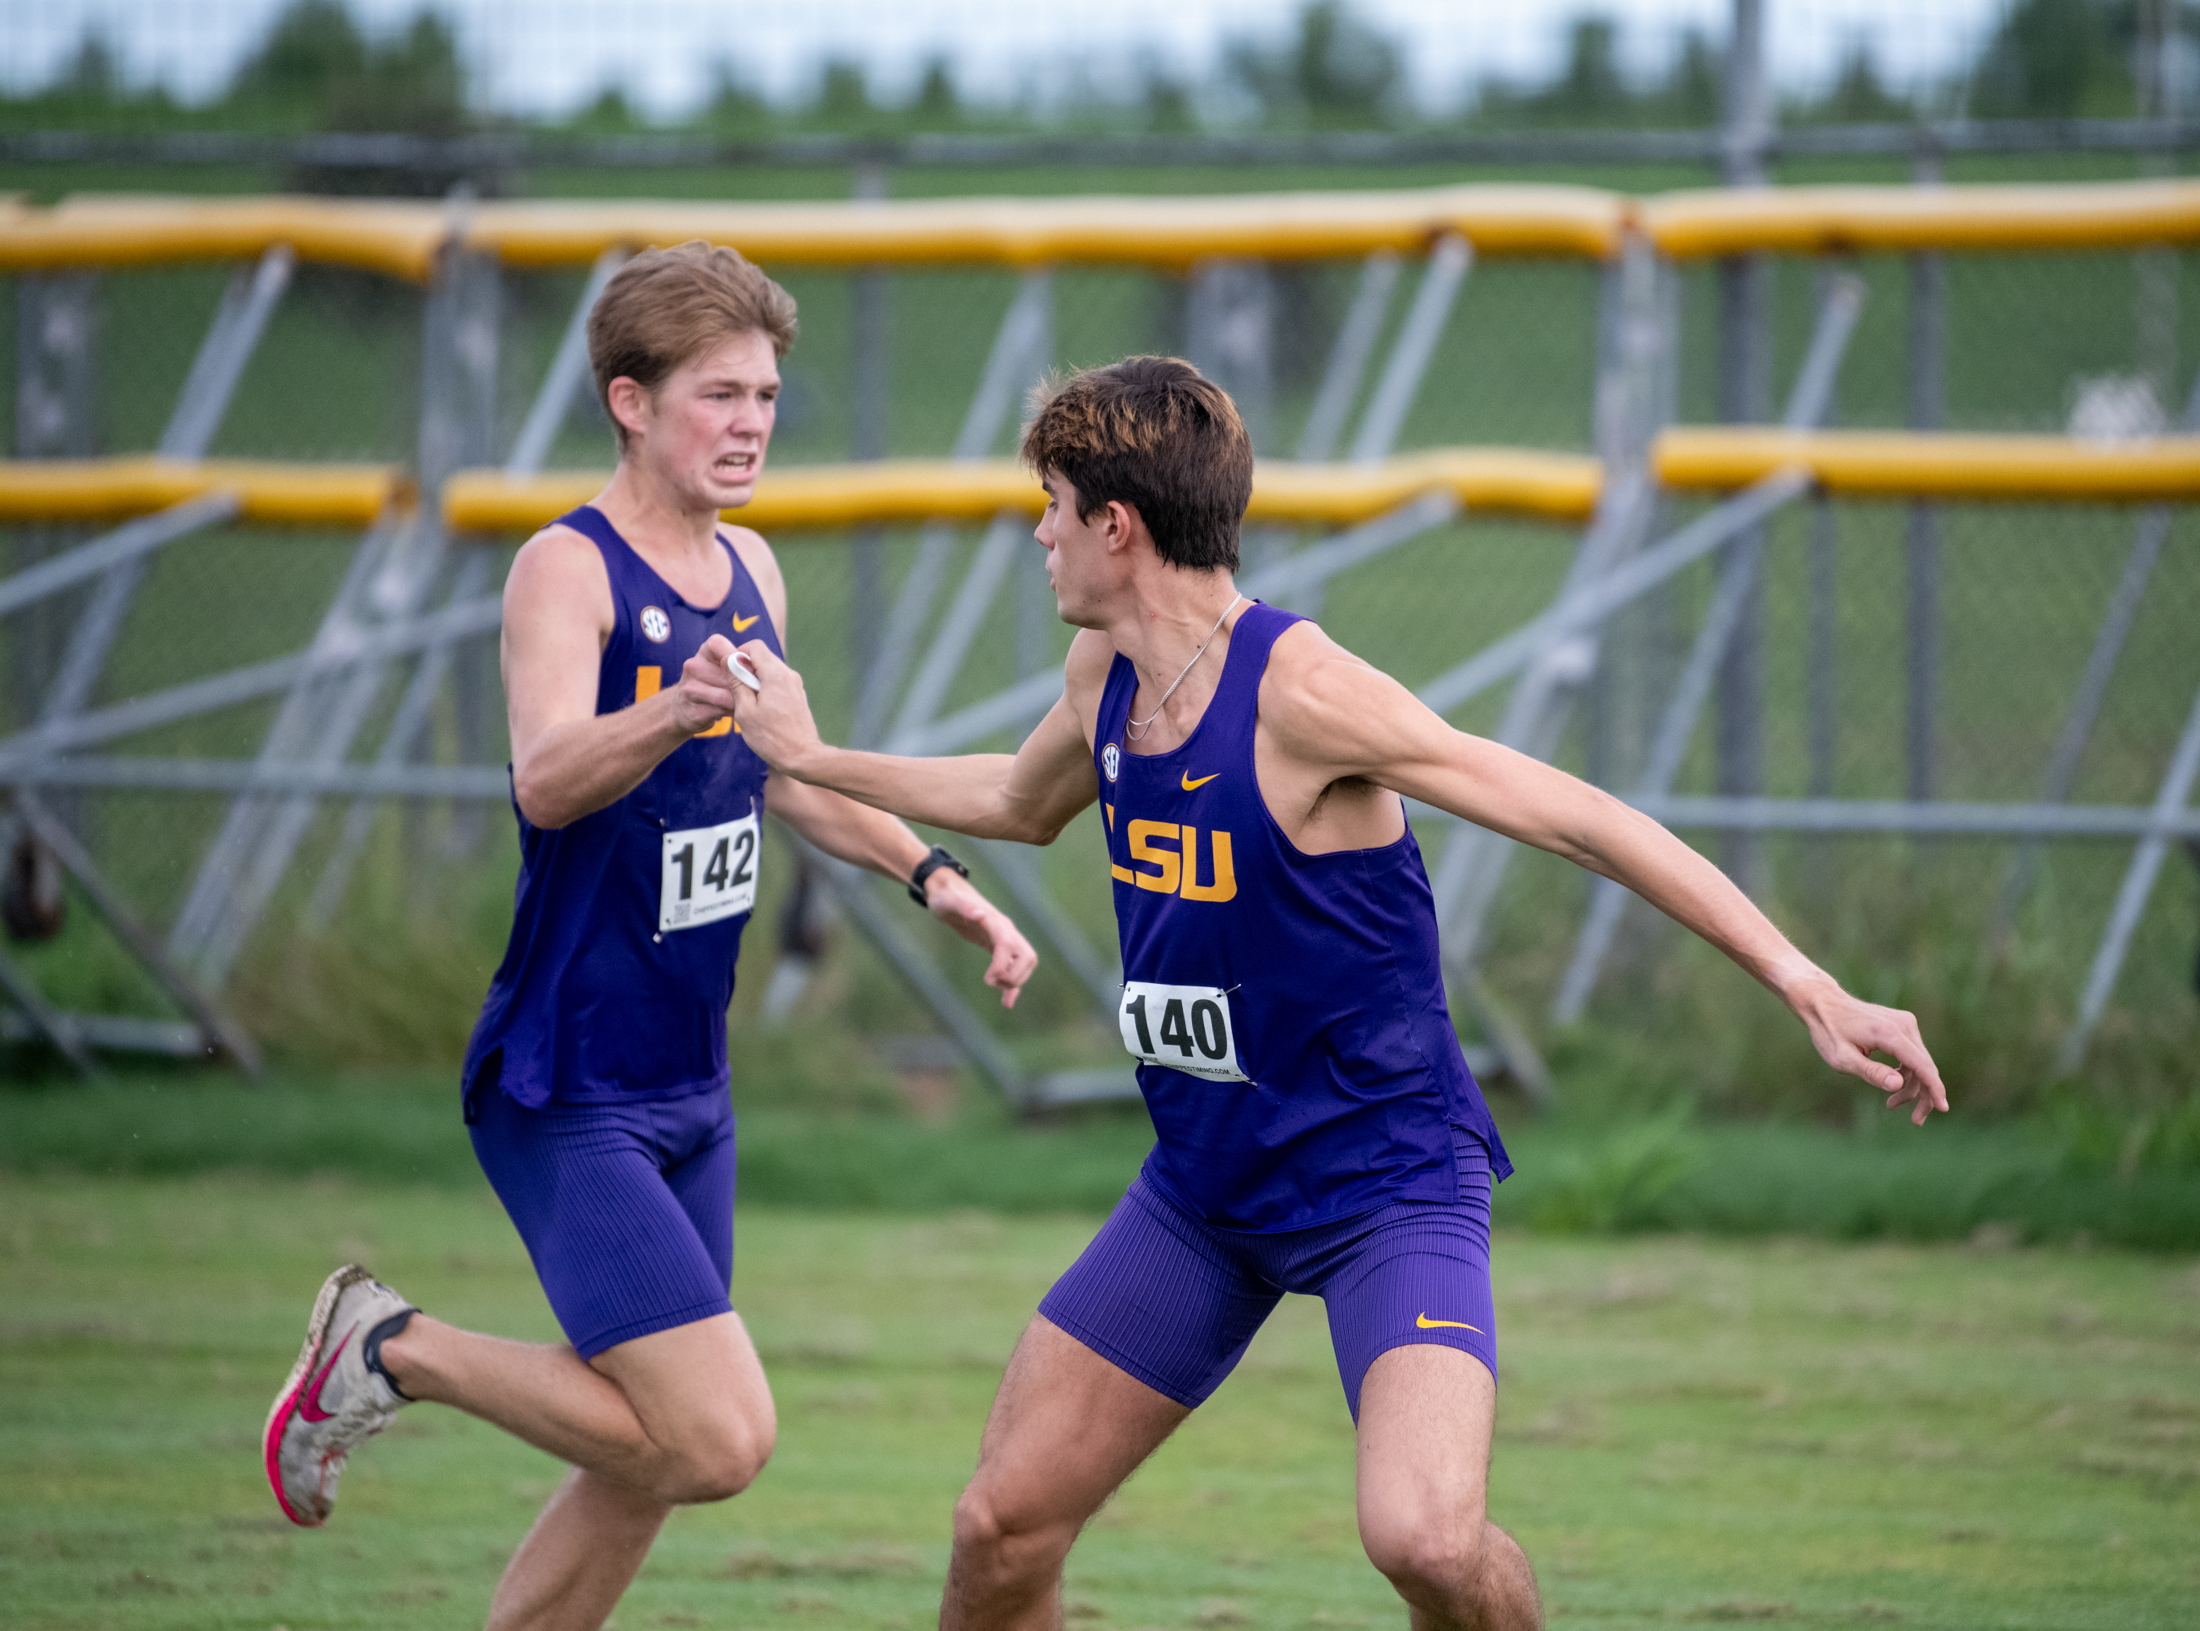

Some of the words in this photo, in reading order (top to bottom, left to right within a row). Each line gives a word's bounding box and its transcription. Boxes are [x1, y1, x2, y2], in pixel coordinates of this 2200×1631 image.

[642, 608, 668, 640] SEC
[671, 828, 755, 901] 142
[1105, 802, 1238, 903] LSU
[1125, 994, 1228, 1060] 140
